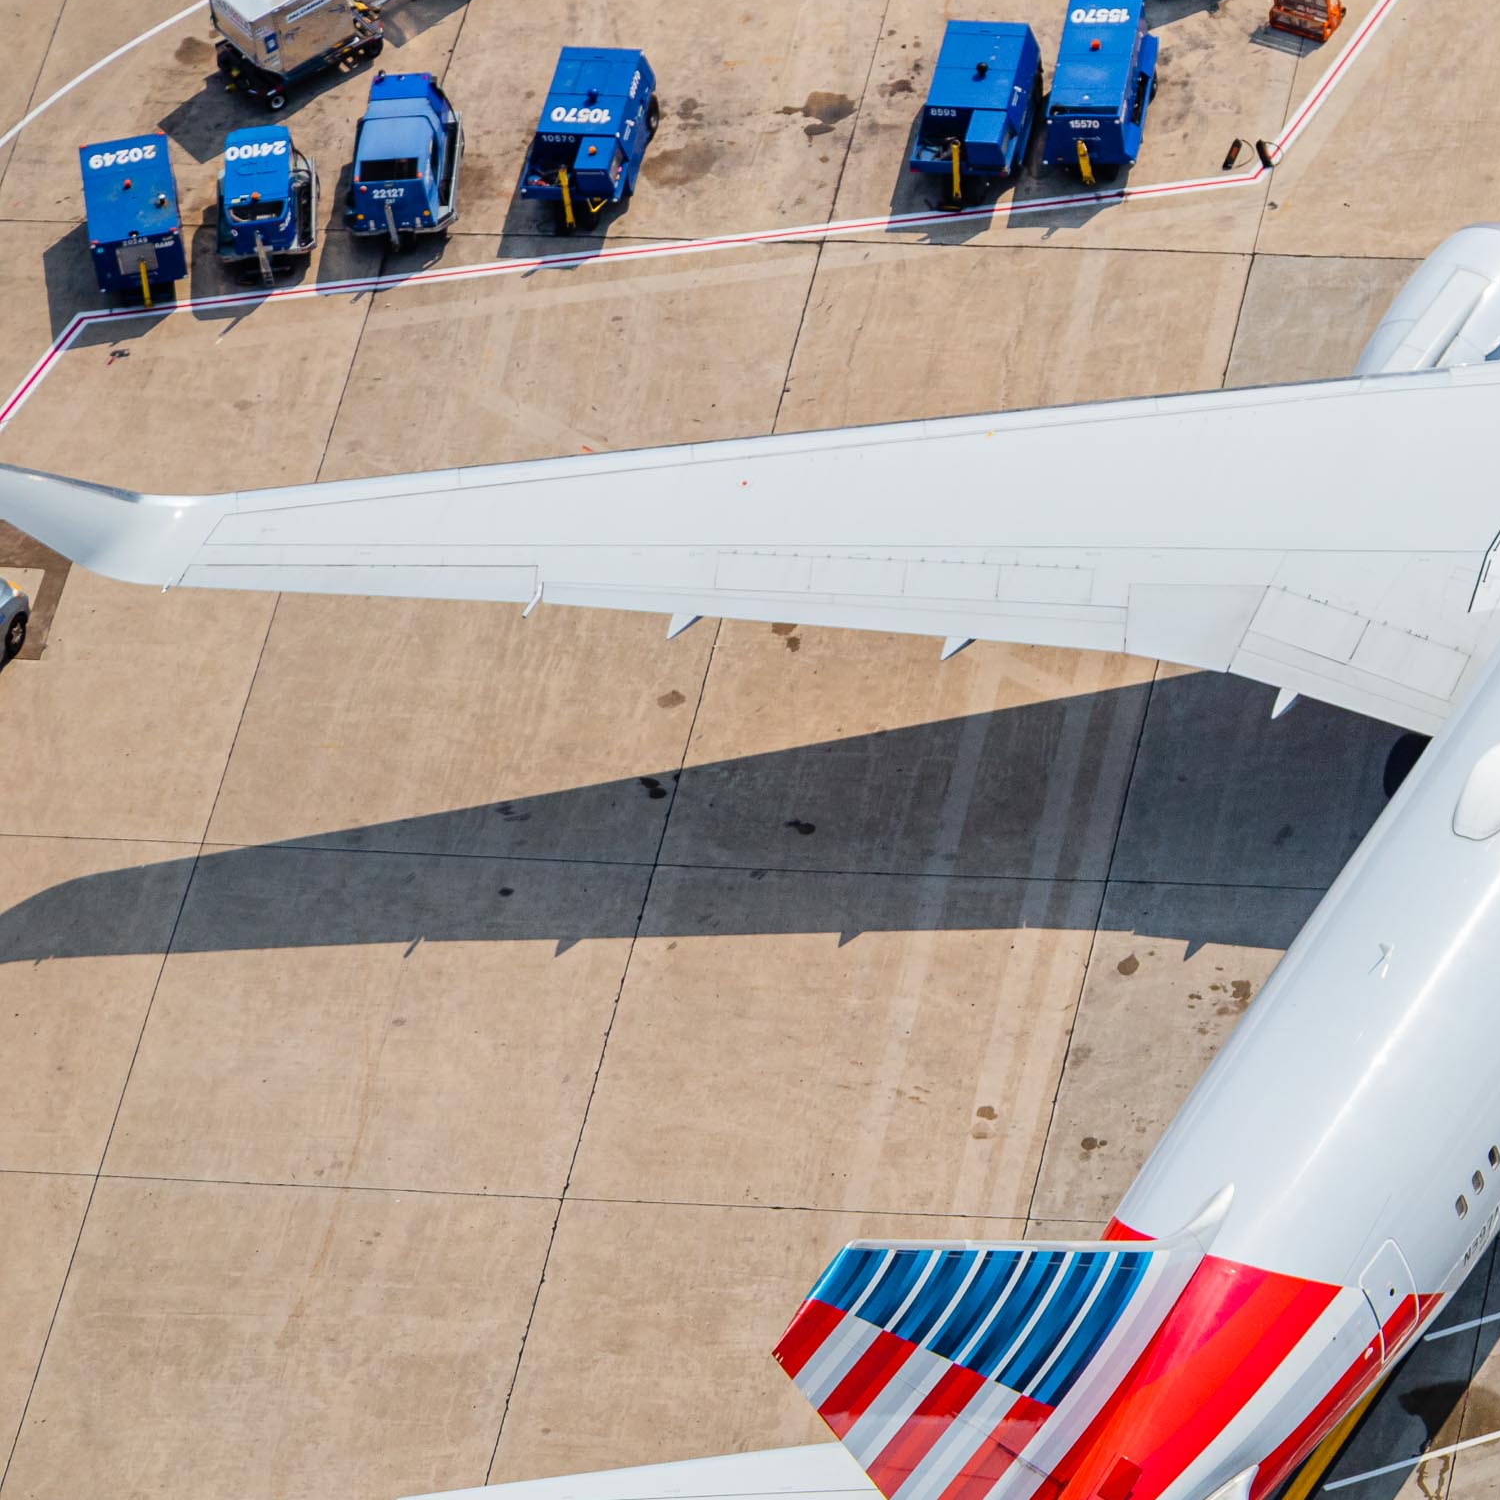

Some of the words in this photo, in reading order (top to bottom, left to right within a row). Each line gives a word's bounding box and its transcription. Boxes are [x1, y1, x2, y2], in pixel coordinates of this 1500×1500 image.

[1070, 8, 1131, 24] 15570
[550, 106, 612, 124] 10570
[1069, 119, 1101, 130] 15570
[541, 134, 576, 143] 10570
[88, 144, 157, 170] 20249
[224, 140, 287, 161] 24100
[372, 187, 405, 199] 22127
